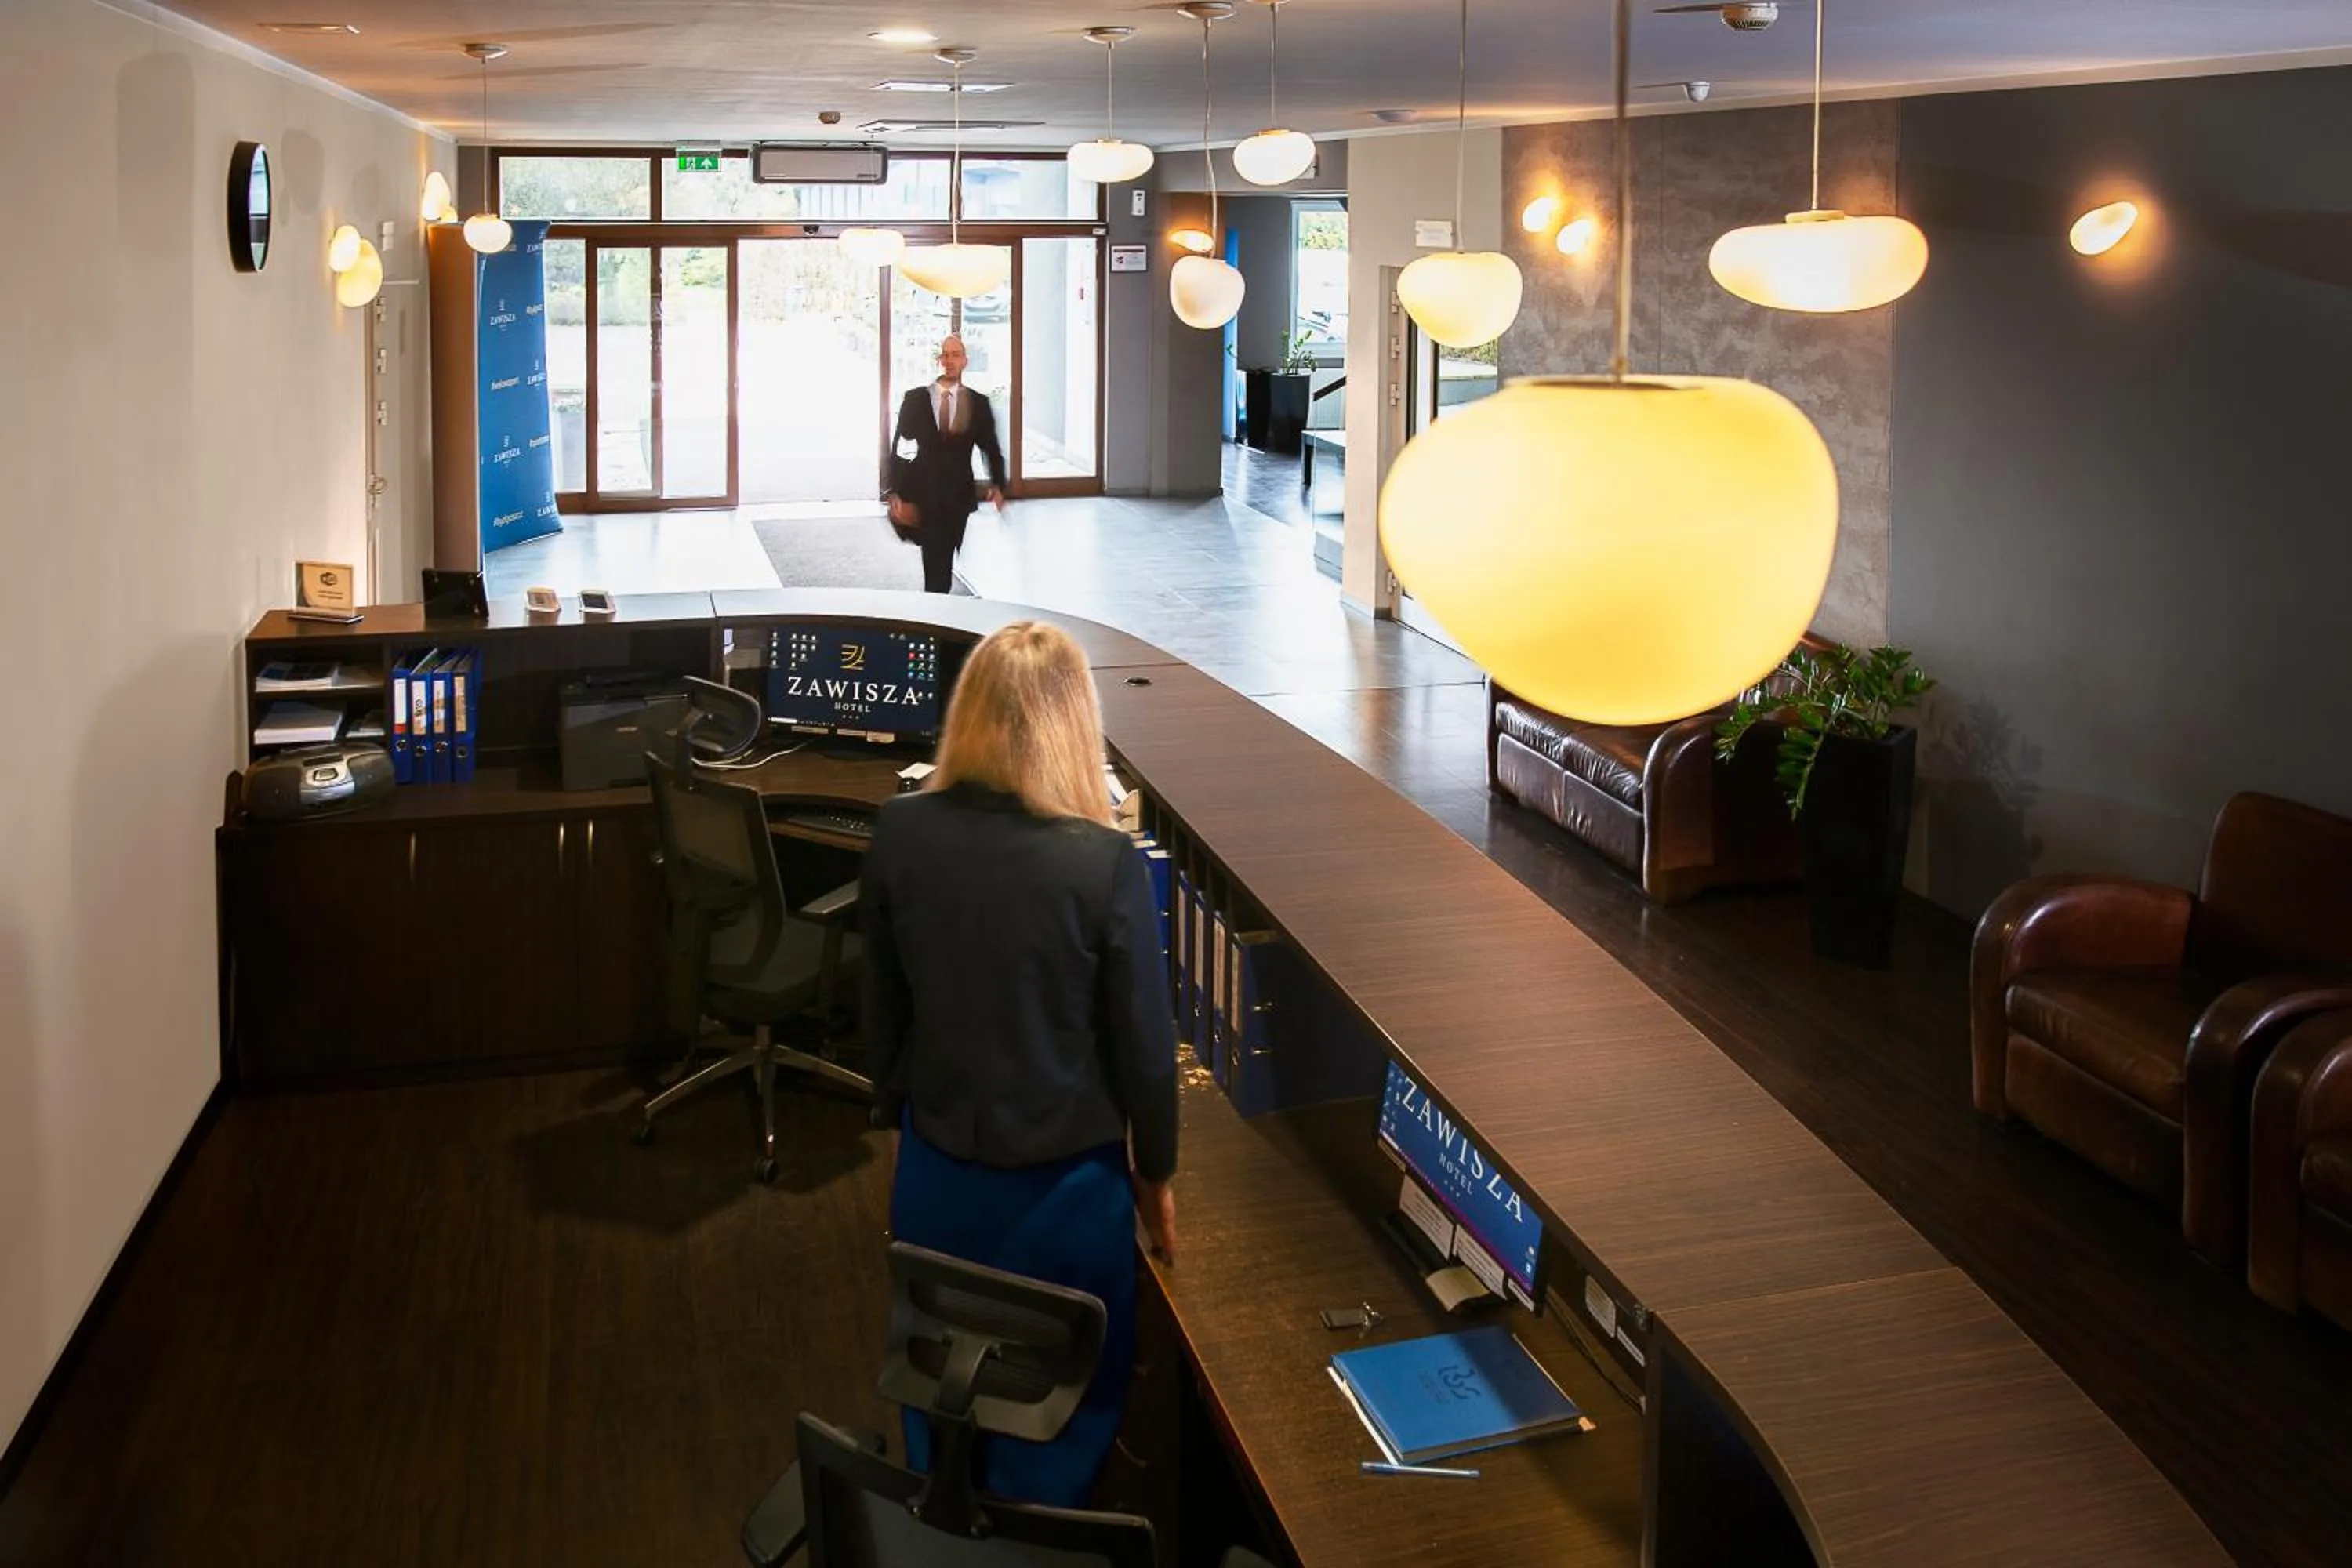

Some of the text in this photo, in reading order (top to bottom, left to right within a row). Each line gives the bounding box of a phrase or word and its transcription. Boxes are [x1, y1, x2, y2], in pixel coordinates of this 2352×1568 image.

[787, 677, 920, 705] ZAWISZA
[834, 702, 871, 713] HOTEL
[1439, 1152, 1475, 1196] HOTEL
